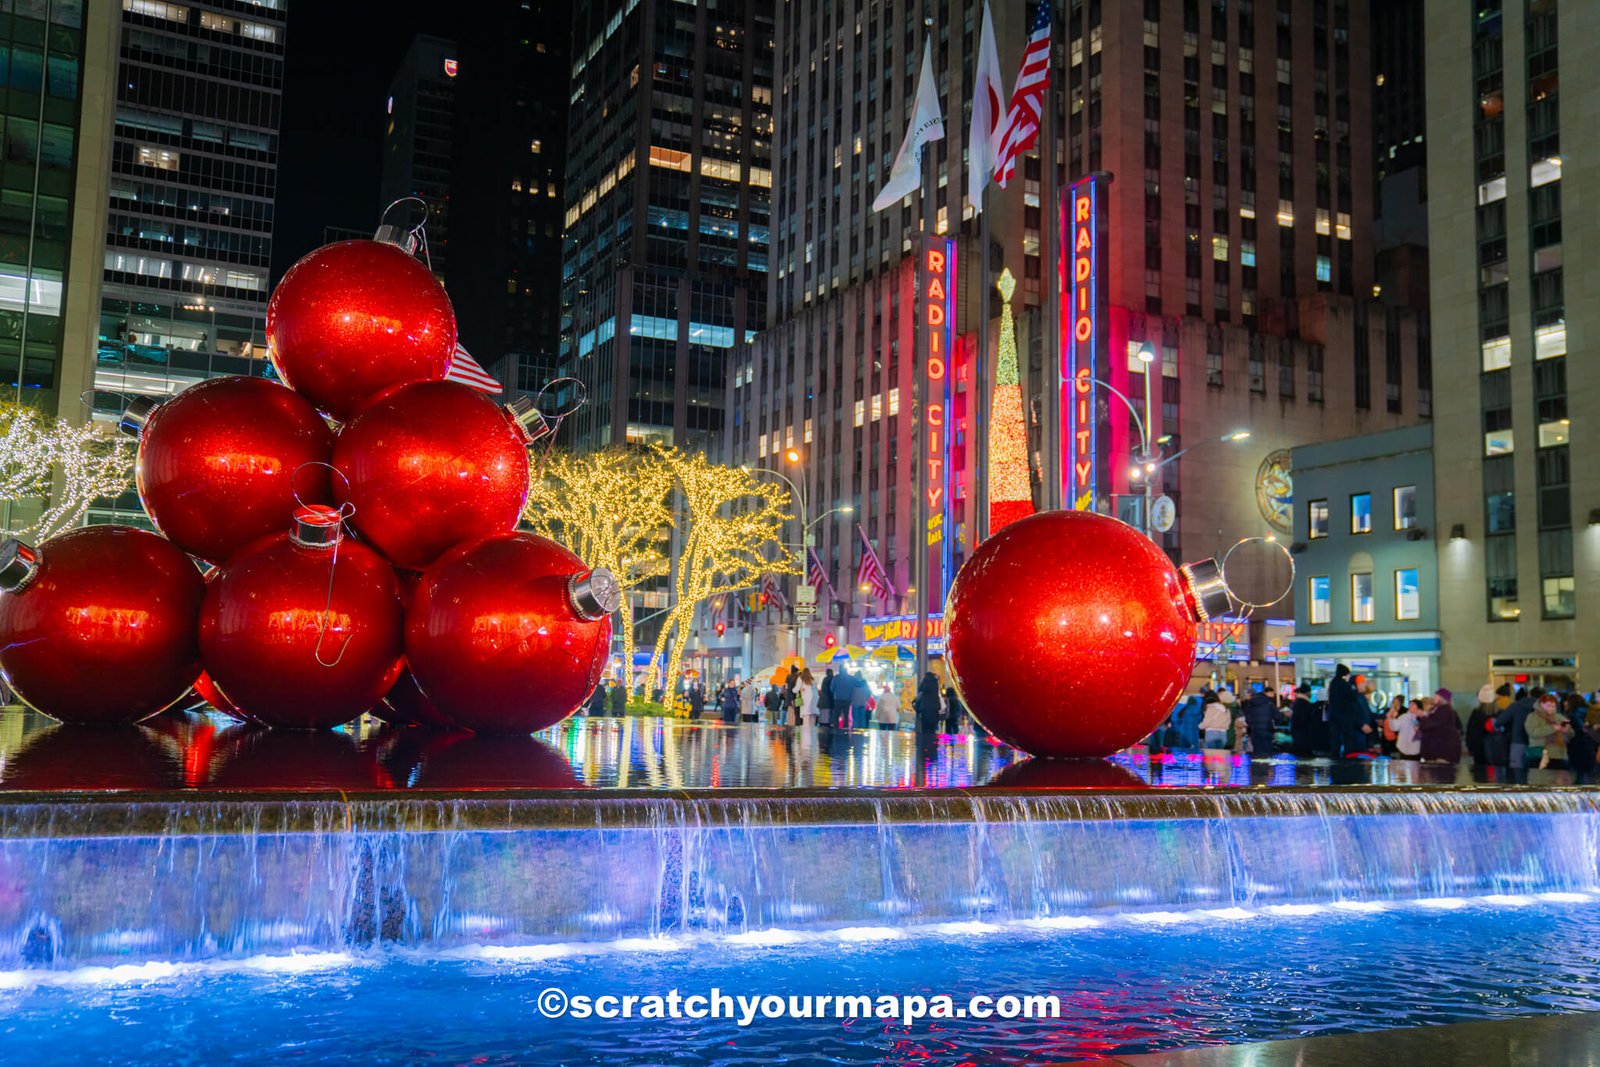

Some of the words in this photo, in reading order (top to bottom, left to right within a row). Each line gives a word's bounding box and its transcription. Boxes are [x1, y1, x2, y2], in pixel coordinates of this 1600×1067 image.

[928, 250, 945, 380] RADIO
[1076, 196, 1092, 342] RADIO
[928, 404, 943, 508] CITY
[1076, 368, 1092, 486] CITY
[1196, 621, 1244, 642] ITY
